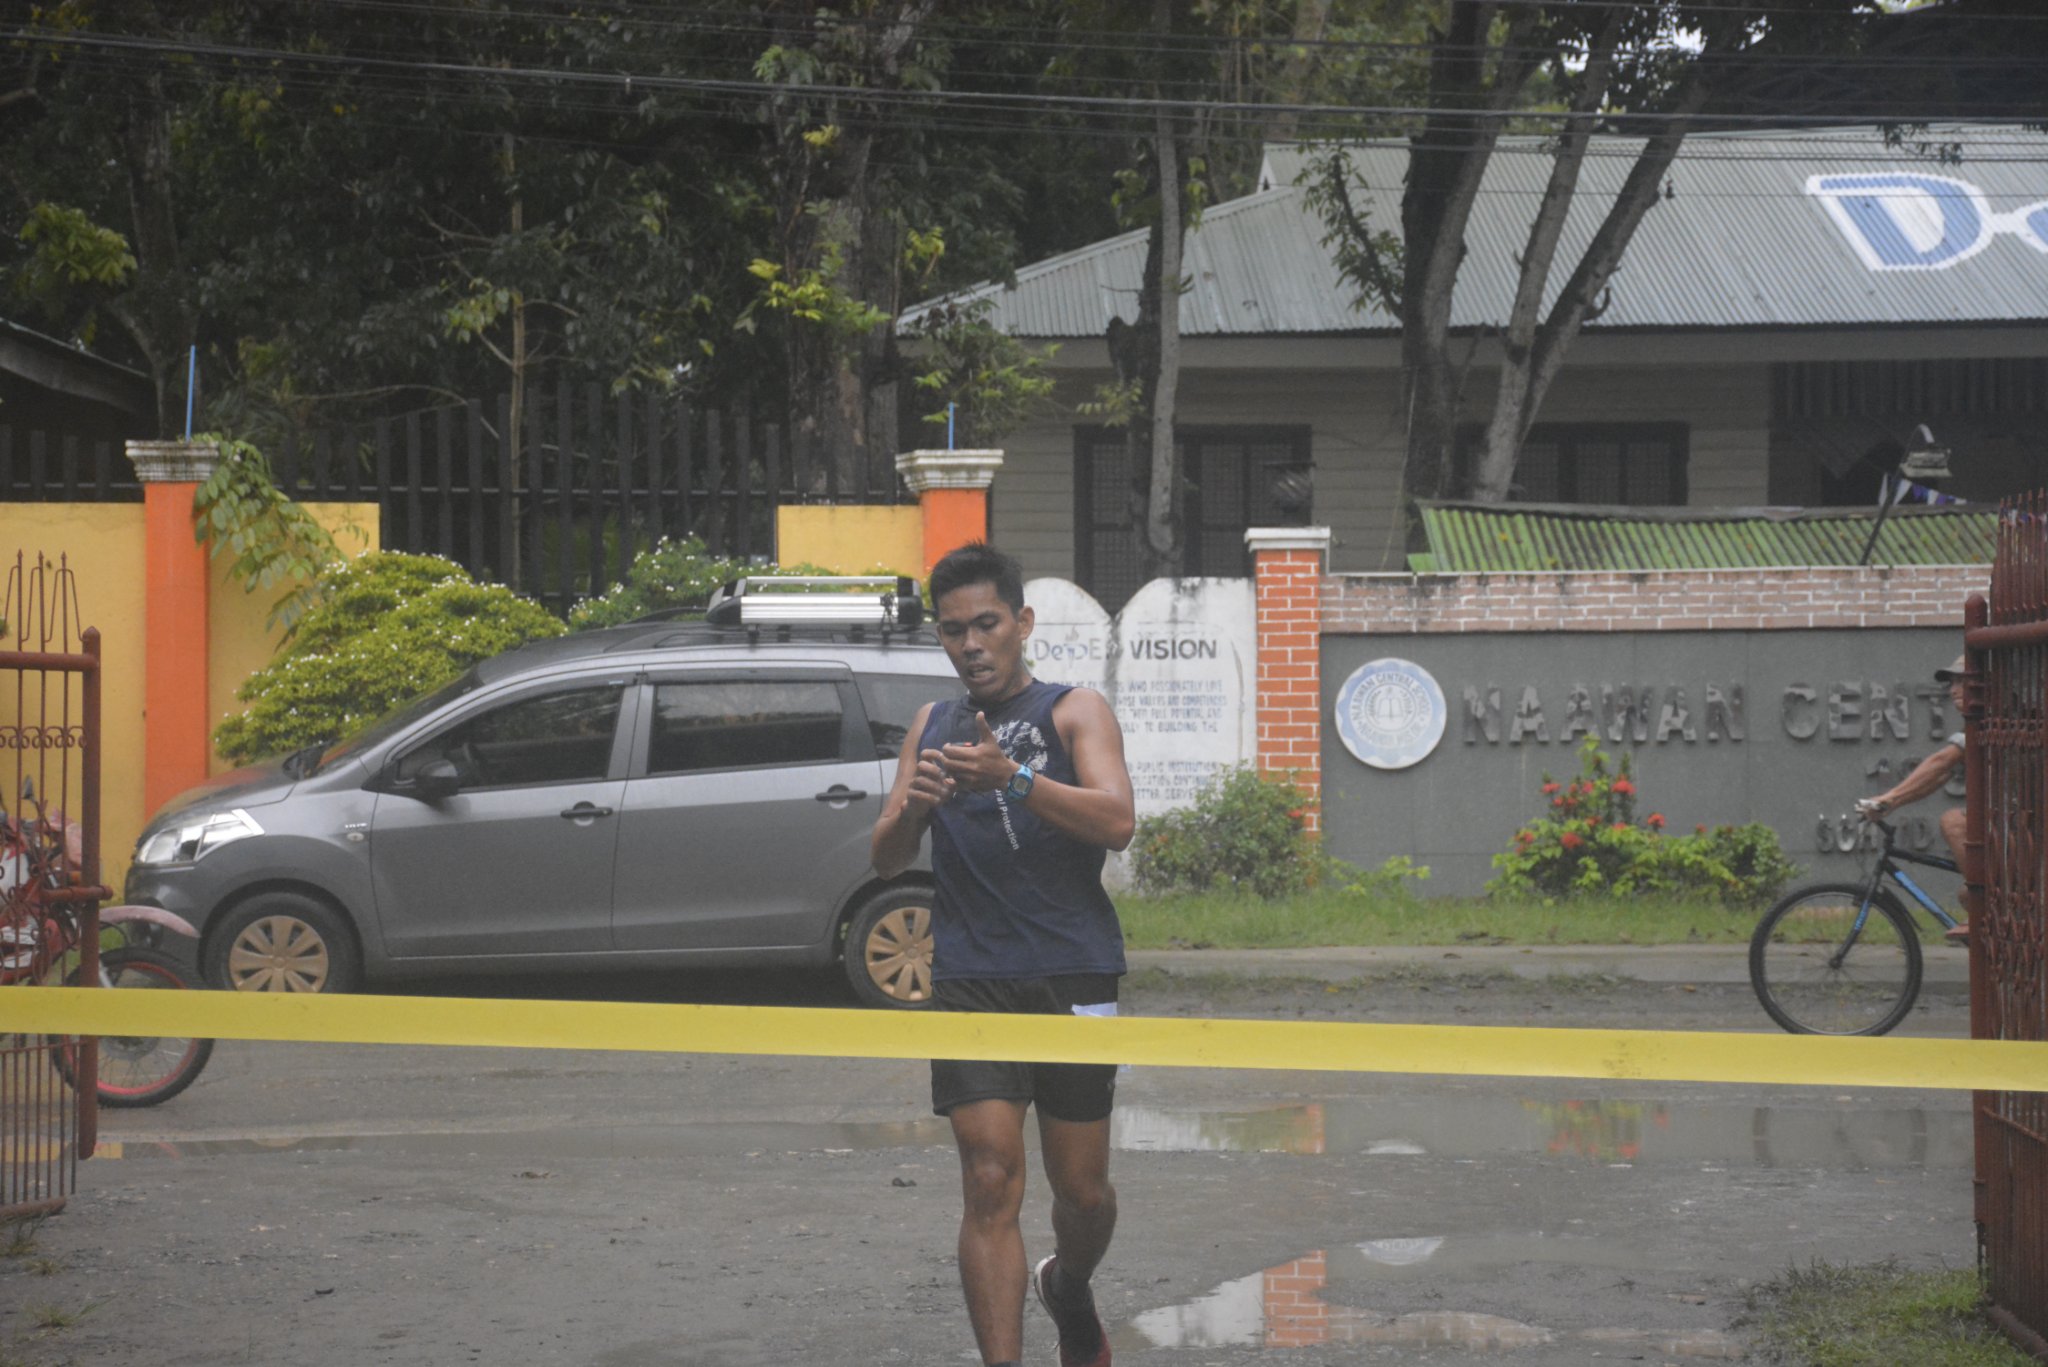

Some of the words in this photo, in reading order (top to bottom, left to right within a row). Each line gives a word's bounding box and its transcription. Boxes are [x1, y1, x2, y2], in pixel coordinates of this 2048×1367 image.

[1130, 638, 1217, 660] VISION
[1461, 684, 1745, 743] NAAWAN
[1782, 682, 1952, 741] CENT
[1000, 806, 1020, 850] Protection
